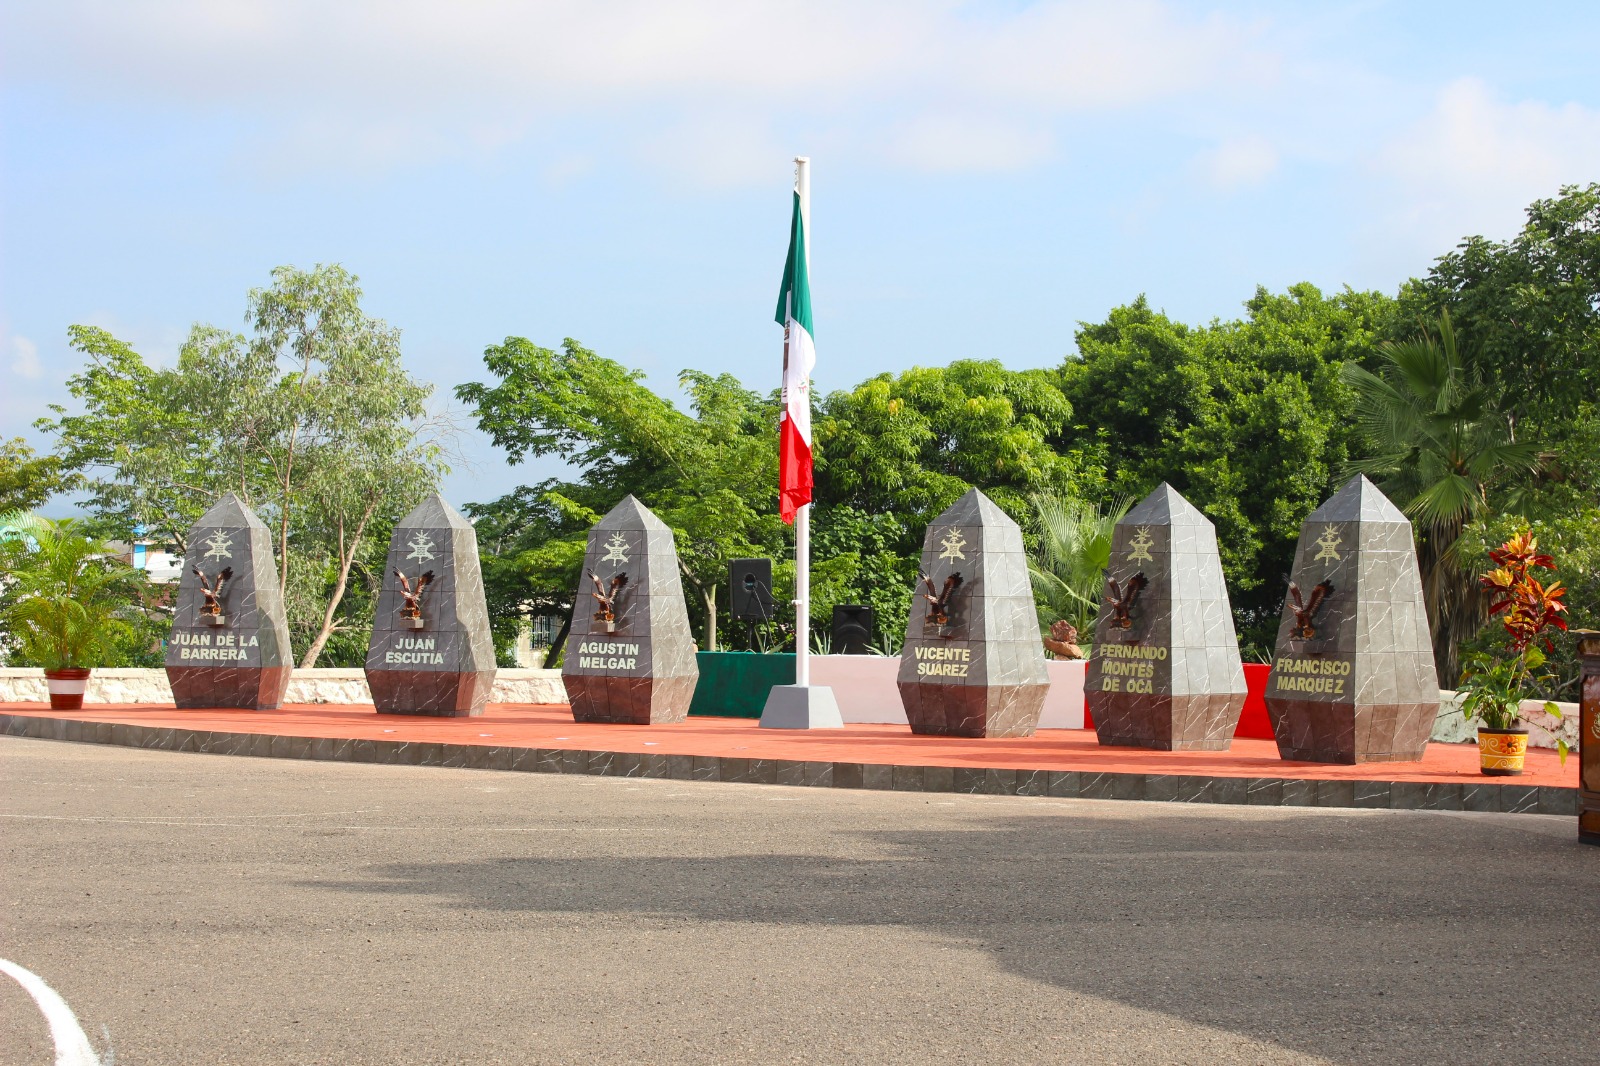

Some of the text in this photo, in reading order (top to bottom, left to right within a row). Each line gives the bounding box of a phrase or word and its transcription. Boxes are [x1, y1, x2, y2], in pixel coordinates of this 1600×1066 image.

[171, 634, 259, 647] JUAN DE LA
[395, 638, 435, 650] JUAN
[180, 648, 248, 660] BARRERA
[578, 641, 639, 656] AGUSTIN
[914, 646, 971, 662] VICENTE
[1099, 643, 1168, 660] FERNANDO
[385, 651, 444, 664] ESCUTIA
[579, 656, 636, 669] MELGAR
[917, 662, 969, 677] SUAREZ
[1101, 660, 1155, 678] MONTES
[1276, 658, 1351, 676] FRANCISCO
[1102, 677, 1153, 694] DE OCA
[1276, 675, 1344, 694] MARQUEZ
